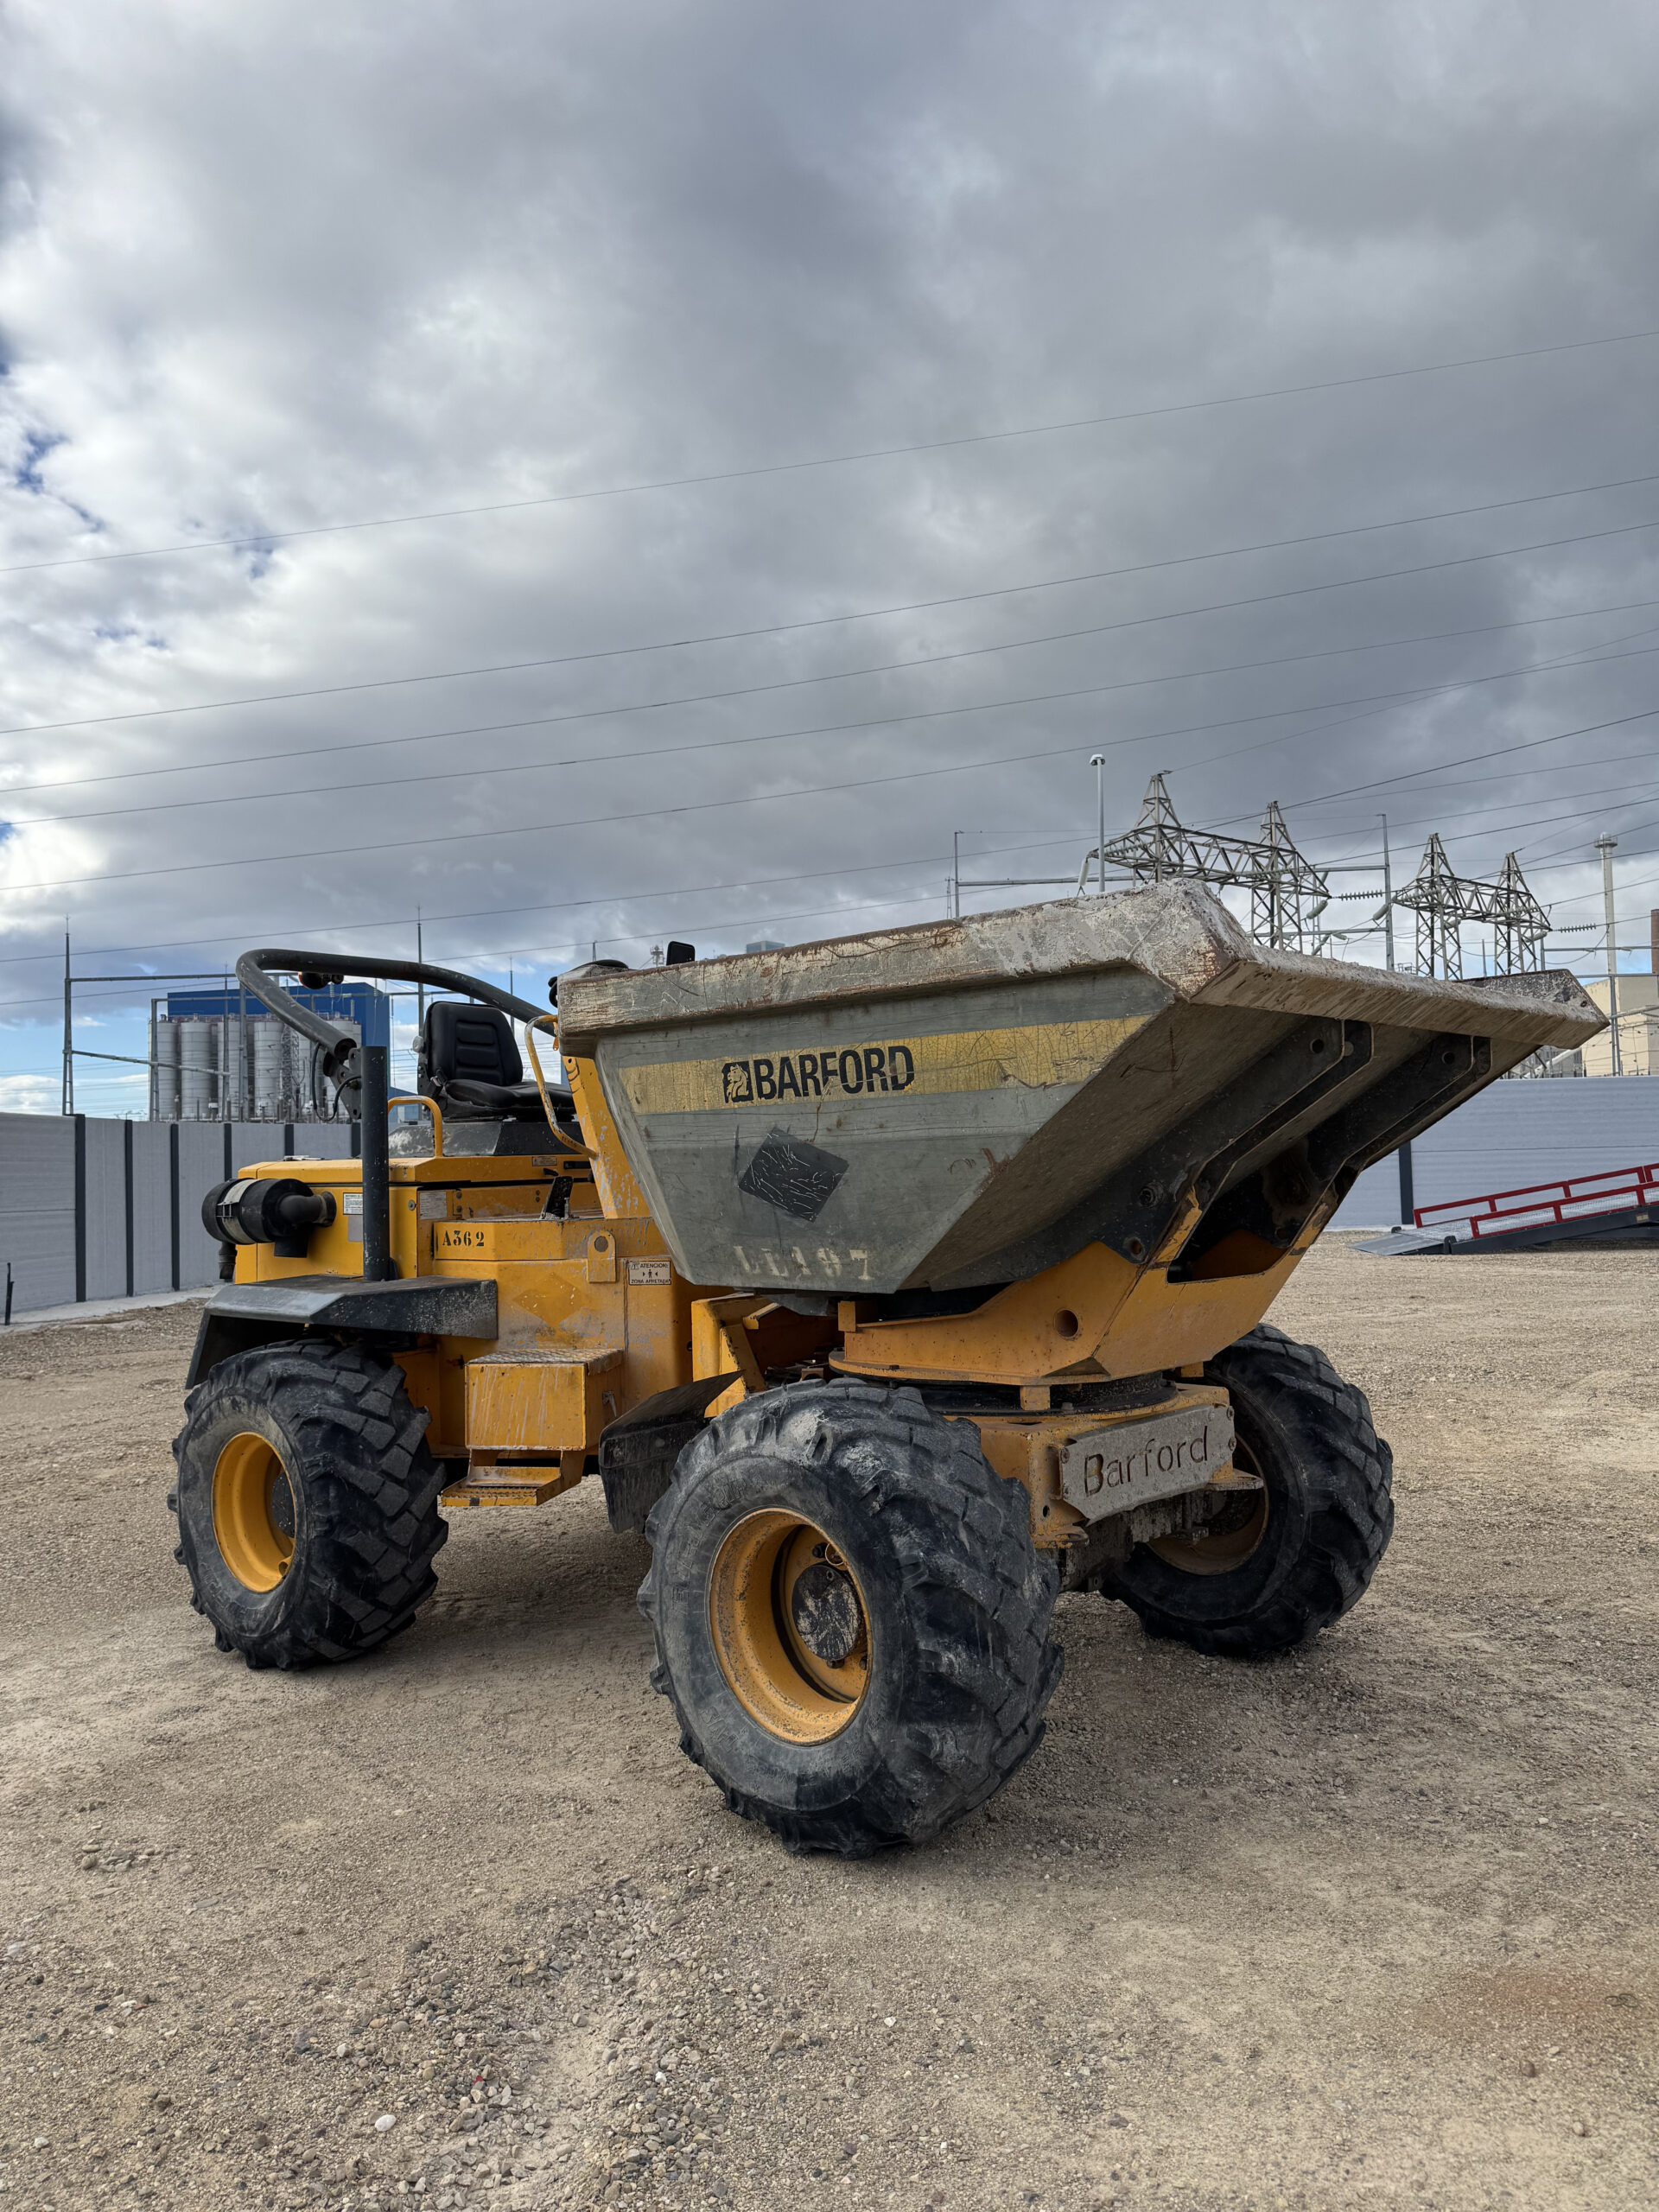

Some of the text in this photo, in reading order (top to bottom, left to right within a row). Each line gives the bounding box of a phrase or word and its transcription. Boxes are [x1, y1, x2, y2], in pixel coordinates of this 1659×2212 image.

[753, 1045, 915, 1101] BARFORD
[442, 1230, 485, 1247] A362
[1084, 1425, 1208, 1498] Barford
